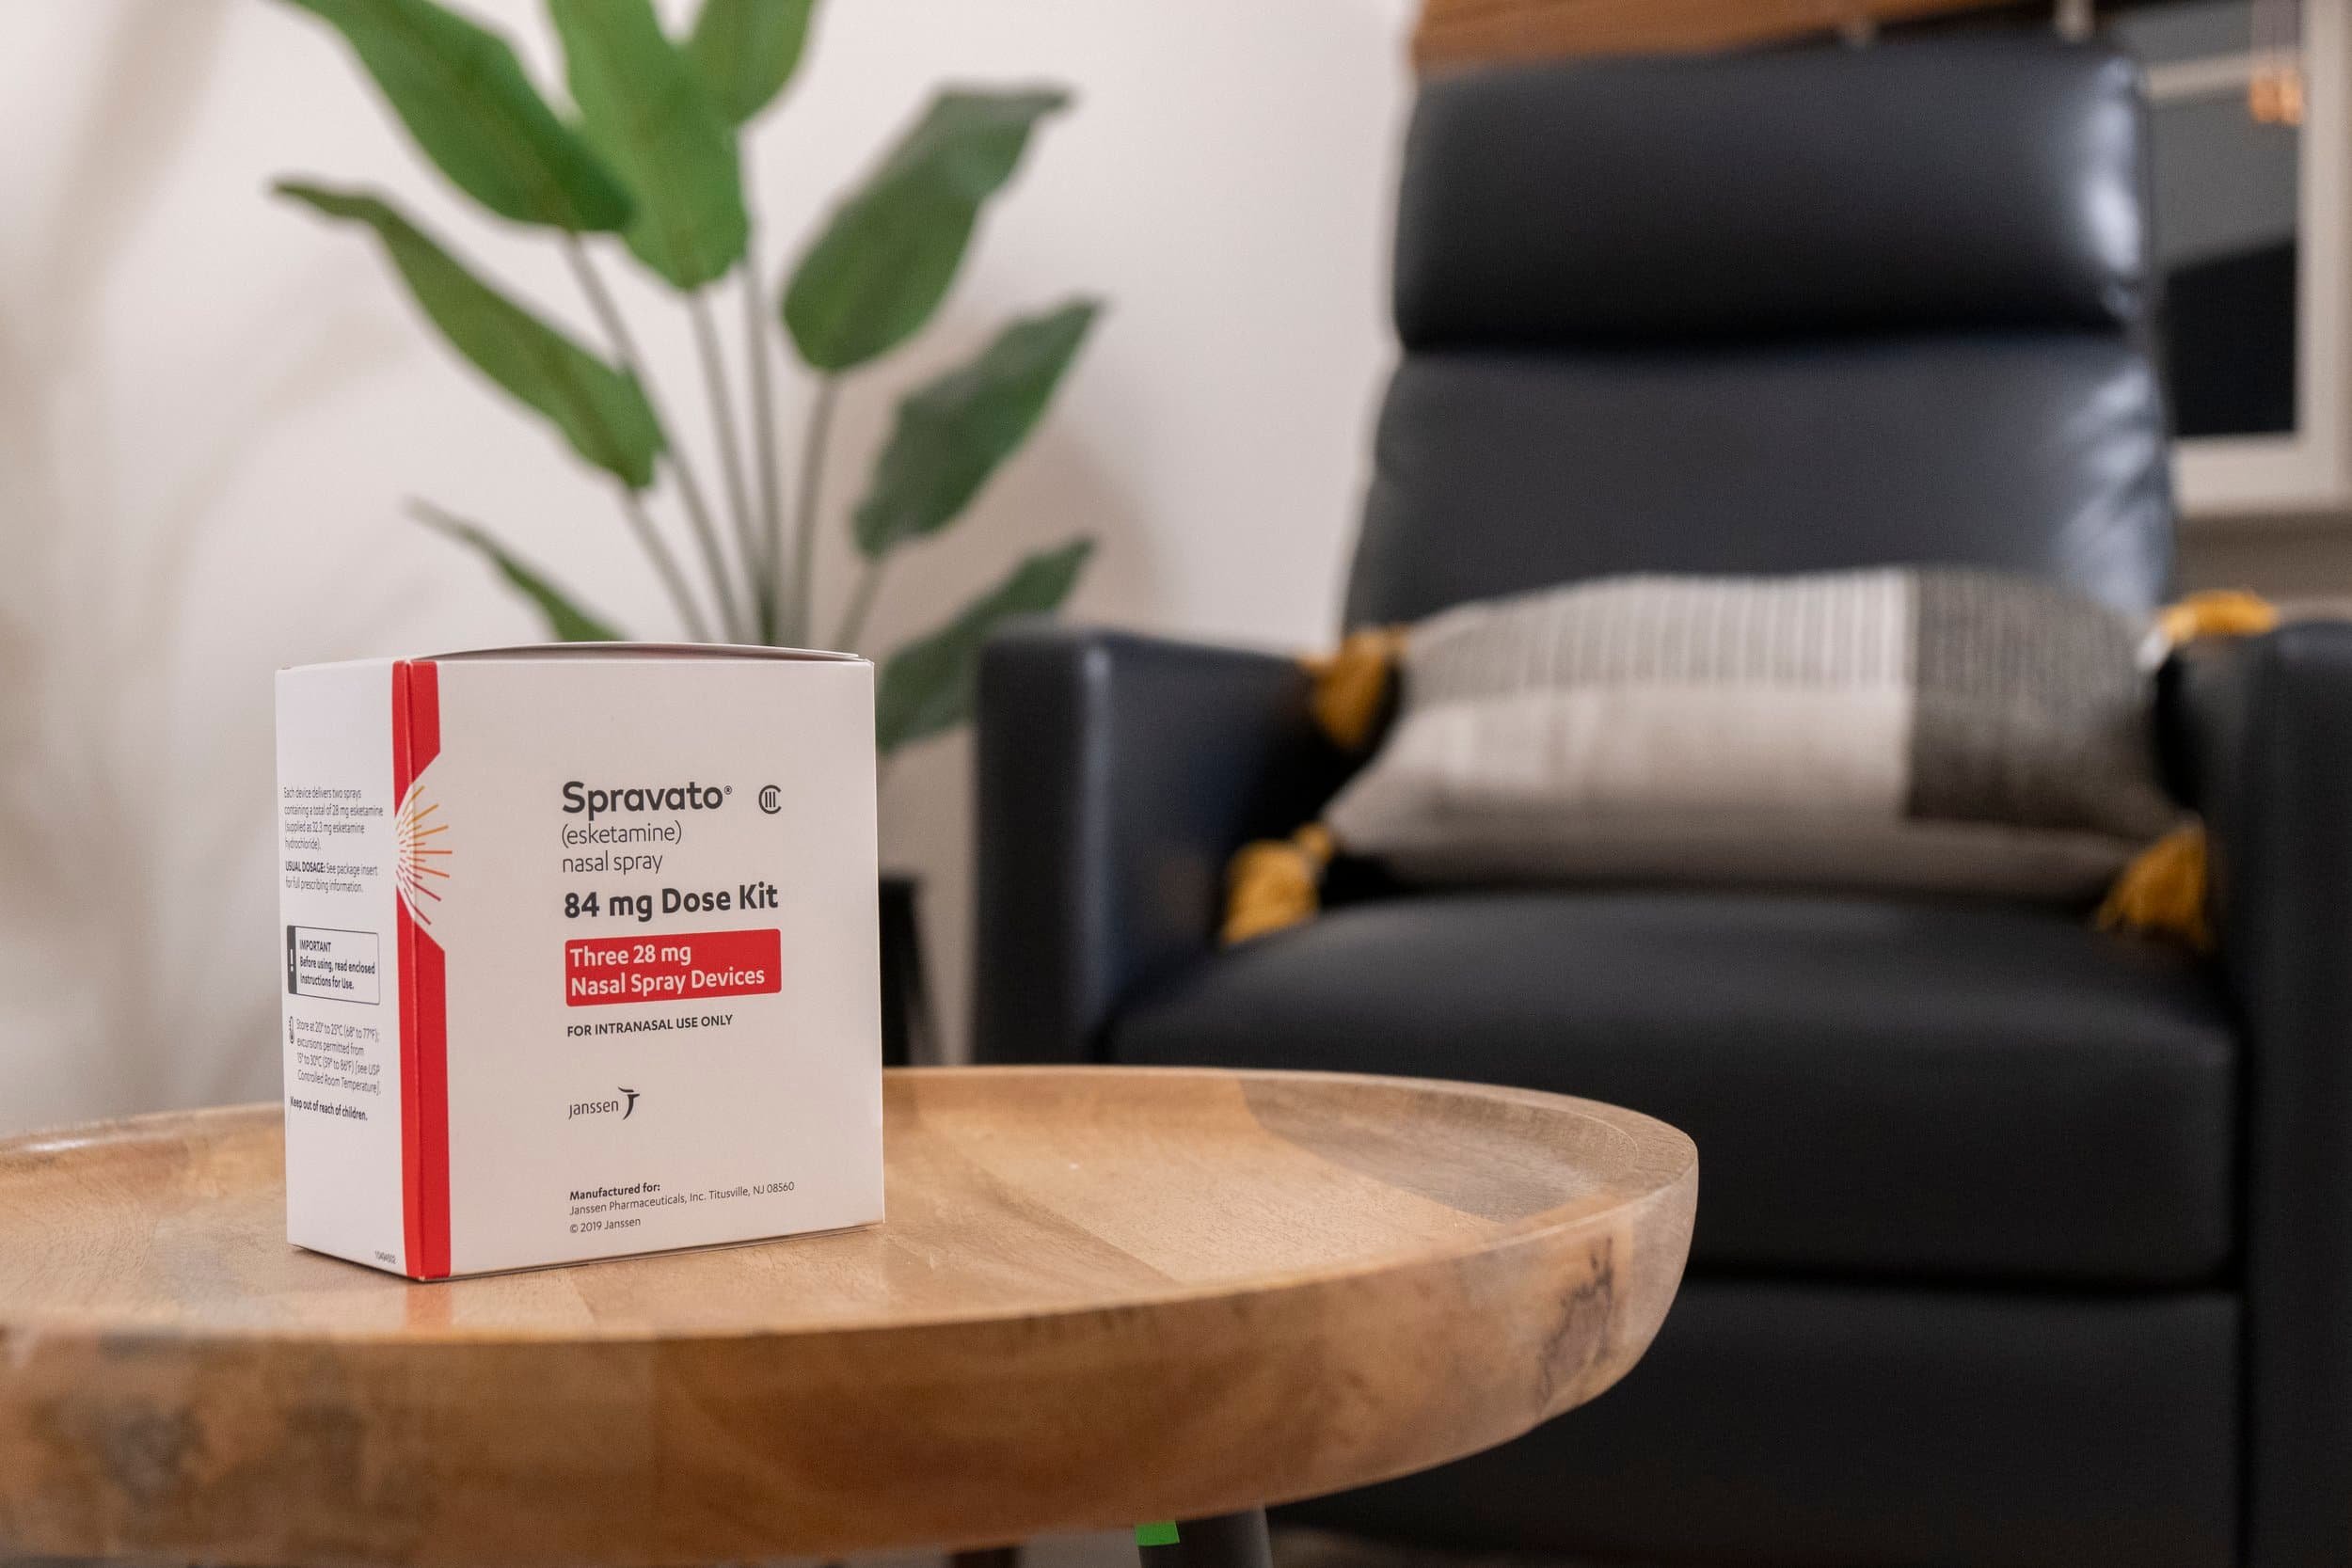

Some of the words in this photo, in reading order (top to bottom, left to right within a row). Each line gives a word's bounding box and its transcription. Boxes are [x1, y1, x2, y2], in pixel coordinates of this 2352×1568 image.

[283, 786, 294, 798] Each
[296, 786, 311, 798] device
[312, 786, 331, 798] delivers
[333, 789, 342, 798] two
[344, 789, 361, 800] sprays
[284, 804, 309, 817] containing
[313, 803, 325, 815] total
[326, 803, 331, 816] of
[332, 805, 339, 816] 28
[340, 807, 349, 818] mg
[350, 806, 383, 816] esketamine
[324, 824, 331, 835] mg
[333, 823, 365, 833] esketamine
[562, 820, 682, 847] (esketamine)
[286, 862, 301, 872] USUAL
[302, 862, 326, 873] DOSAGE:
[326, 863, 336, 873] See
[337, 863, 360, 878] package
[361, 865, 377, 876] insert
[563, 850, 609, 873] nasal
[613, 855, 662, 875] spray
[301, 879, 328, 893] prescribing
[329, 879, 362, 892] information.
[564, 892, 599, 918] 84
[610, 895, 652, 922] mg
[662, 889, 730, 912] Dose
[739, 881, 778, 909] Kit
[300, 940, 331, 952] IMPORTANT
[570, 946, 628, 967] Three
[633, 944, 655, 963] 28
[661, 946, 691, 966] mg
[301, 956, 316, 968] Before
[318, 958, 333, 972] using,
[335, 959, 347, 971] read
[349, 960, 374, 974] enclosed
[301, 974, 331, 987] Instructions
[332, 975, 341, 988] for
[342, 978, 354, 990] Use.
[571, 973, 626, 996] Nasal
[631, 974, 686, 996] Spray
[691, 967, 764, 989] Devices
[296, 1019, 309, 1031] Store
[310, 1022, 314, 1031] at
[325, 1024, 329, 1034] to
[356, 1029, 361, 1038] to
[567, 1025, 592, 1037] FOR
[595, 1021, 673, 1035] INTRANASAL
[676, 1017, 697, 1028] USE
[701, 1015, 733, 1026] ONLY
[297, 1038, 322, 1050] excursions
[324, 1041, 349, 1054] permitted
[351, 1043, 364, 1055] from
[304, 1056, 309, 1065] to
[334, 1061, 339, 1069] to
[369, 1064, 380, 1075] USP
[298, 1069, 323, 1084] Controlled
[325, 1074, 340, 1085] Room
[291, 1096, 302, 1110] Keep
[304, 1101, 312, 1110] out
[313, 1100, 319, 1111] of
[320, 1102, 334, 1114] reach
[335, 1104, 342, 1116] of
[342, 1106, 367, 1120] children.
[569, 1183, 640, 1200] Manufactured
[643, 1182, 660, 1192] for:
[569, 1203, 606, 1215] Janssen
[610, 1194, 687, 1212] Pharmaceuticals,
[690, 1192, 706, 1202] Inc.
[709, 1187, 750, 1199] Titusville,
[754, 1185, 764, 1195] NJ
[767, 1181, 794, 1193] 08560
[580, 1221, 602, 1232] 2019
[605, 1218, 641, 1229] Janssen
